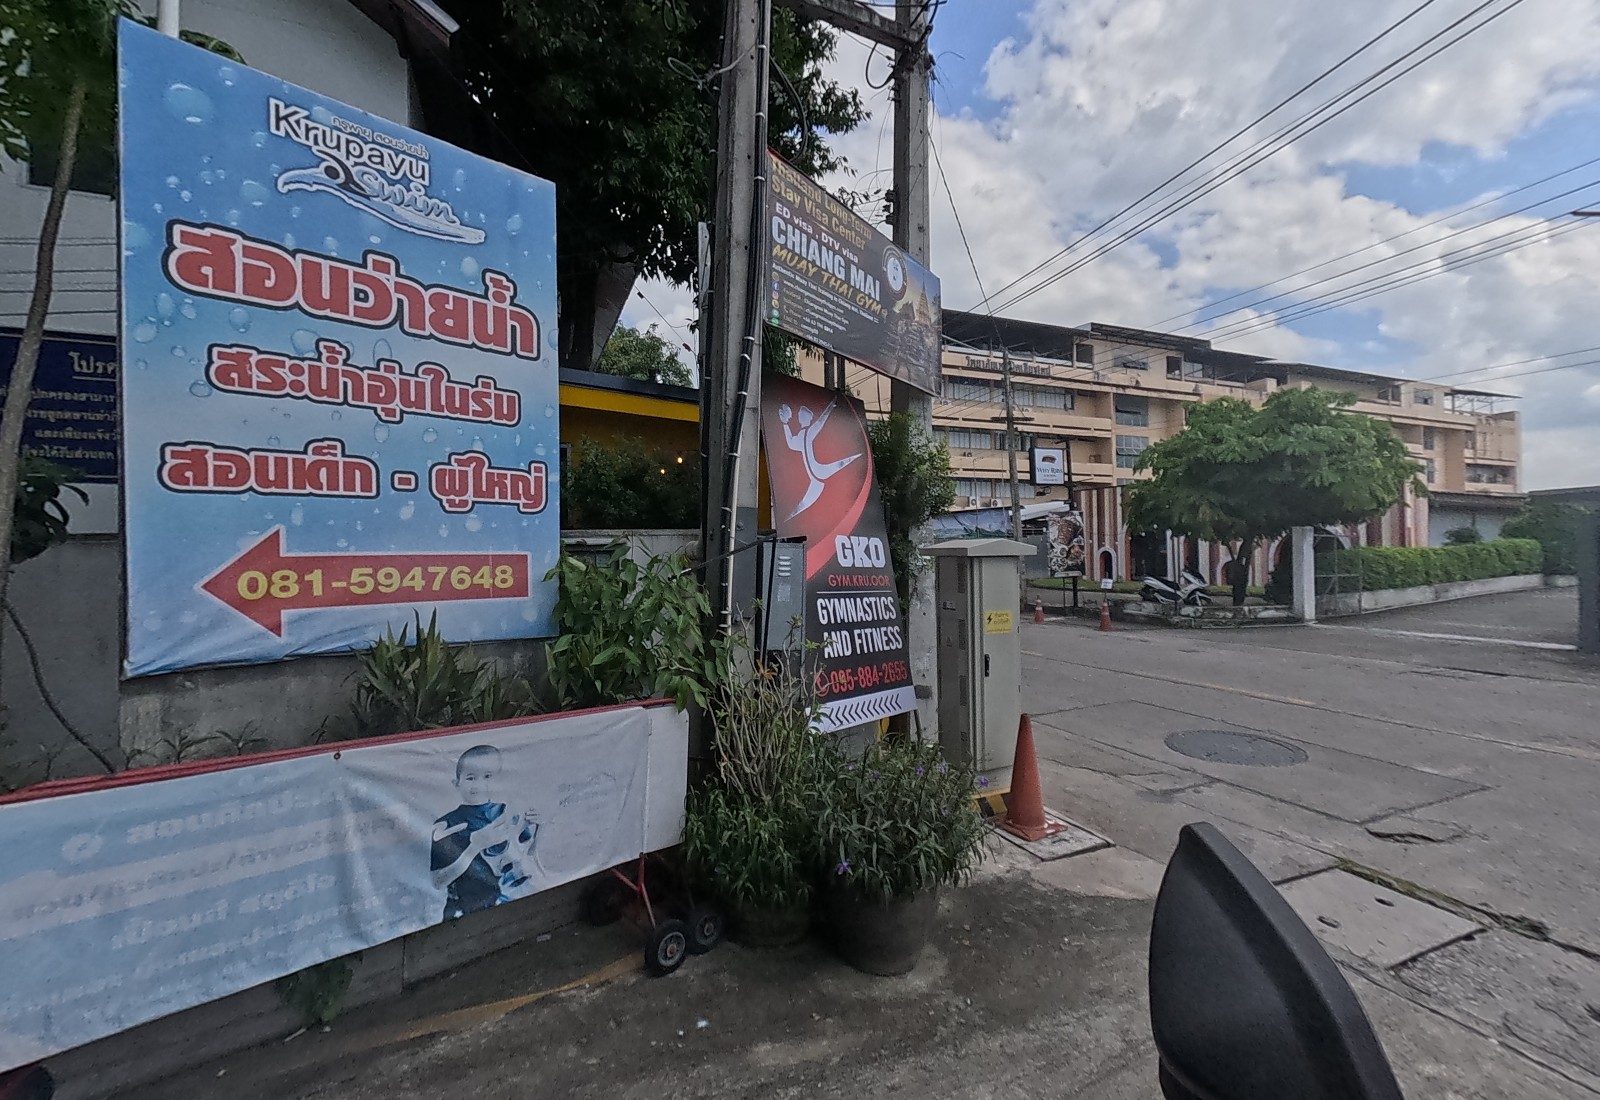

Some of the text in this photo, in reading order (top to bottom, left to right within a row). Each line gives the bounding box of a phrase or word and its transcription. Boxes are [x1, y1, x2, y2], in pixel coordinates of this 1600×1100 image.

[269, 97, 430, 186] Krupayu
[772, 174, 866, 250] Stay Visa Center
[775, 201, 791, 219] ED
[793, 215, 813, 235] visa
[821, 231, 841, 251] DTV
[842, 247, 859, 264] visa
[167, 222, 540, 359] สอนว่ายน้ำ
[772, 216, 847, 281] CHIANG
[850, 264, 881, 302] MAI
[772, 244, 818, 278] MUAY
[821, 271, 853, 299] THAI
[208, 340, 520, 425] สระน้ำอุ่นในร่ม
[160, 439, 378, 498] สอนเด็ก
[430, 451, 547, 513] ผู้ใหญ่
[236, 564, 515, 601] 081-5947648
[835, 534, 886, 569] GKO
[817, 596, 897, 626] GYMNASTICS
[824, 625, 903, 659] AND FITNESS
